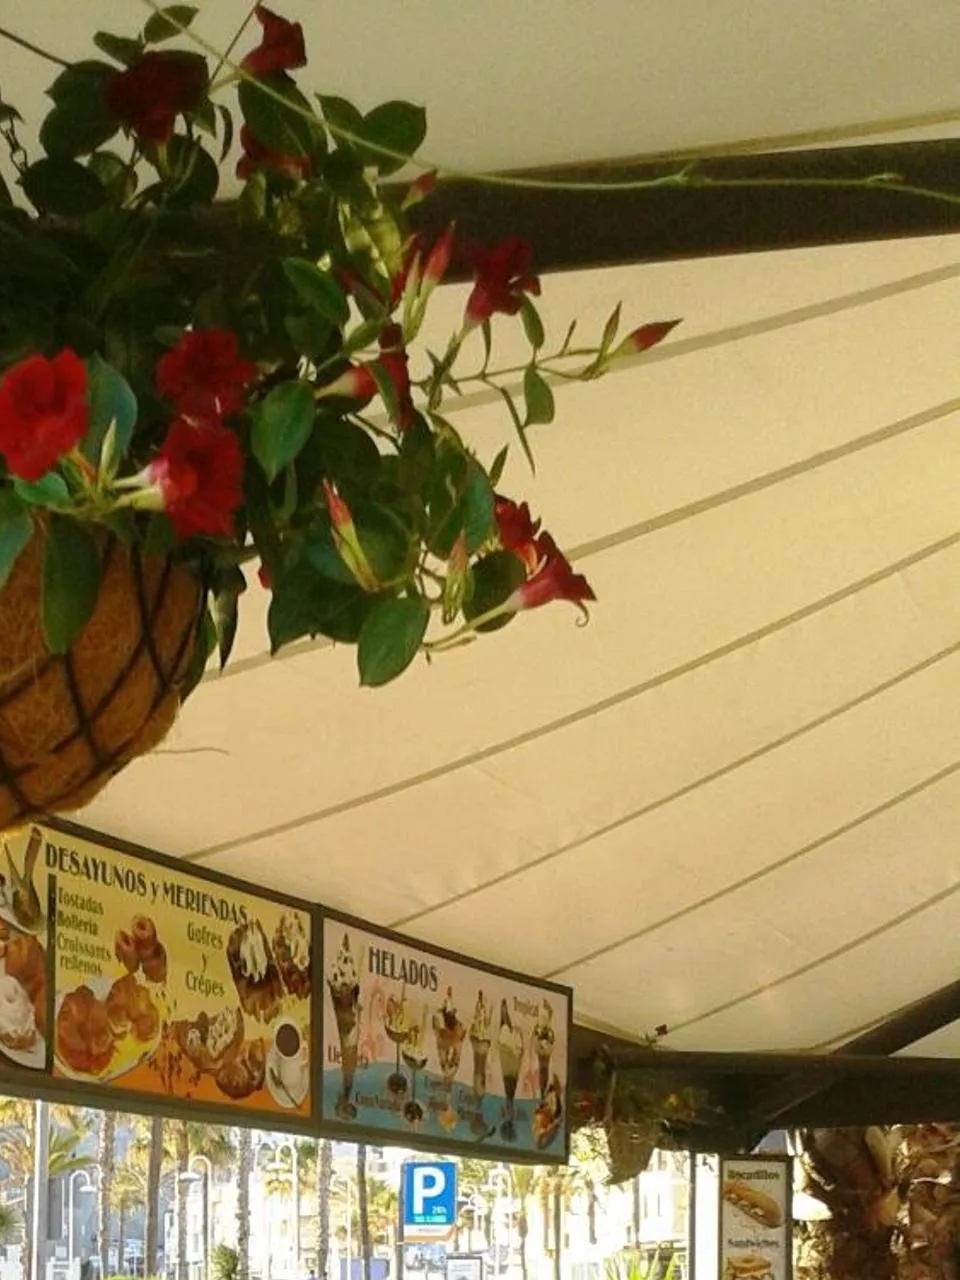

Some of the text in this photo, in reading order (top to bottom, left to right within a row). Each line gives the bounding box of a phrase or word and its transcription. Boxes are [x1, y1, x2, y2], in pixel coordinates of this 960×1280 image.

[45, 842, 146, 897] DESAYUNOS
[163, 883, 248, 926] MERIENDAS
[57, 887, 104, 915] Tostadas
[57, 932, 111, 961] Croissants
[187, 921, 223, 950] Gofres
[368, 947, 438, 992] HELADOS
[728, 1170, 780, 1180] Bocadillos
[413, 1167, 446, 1214] P
